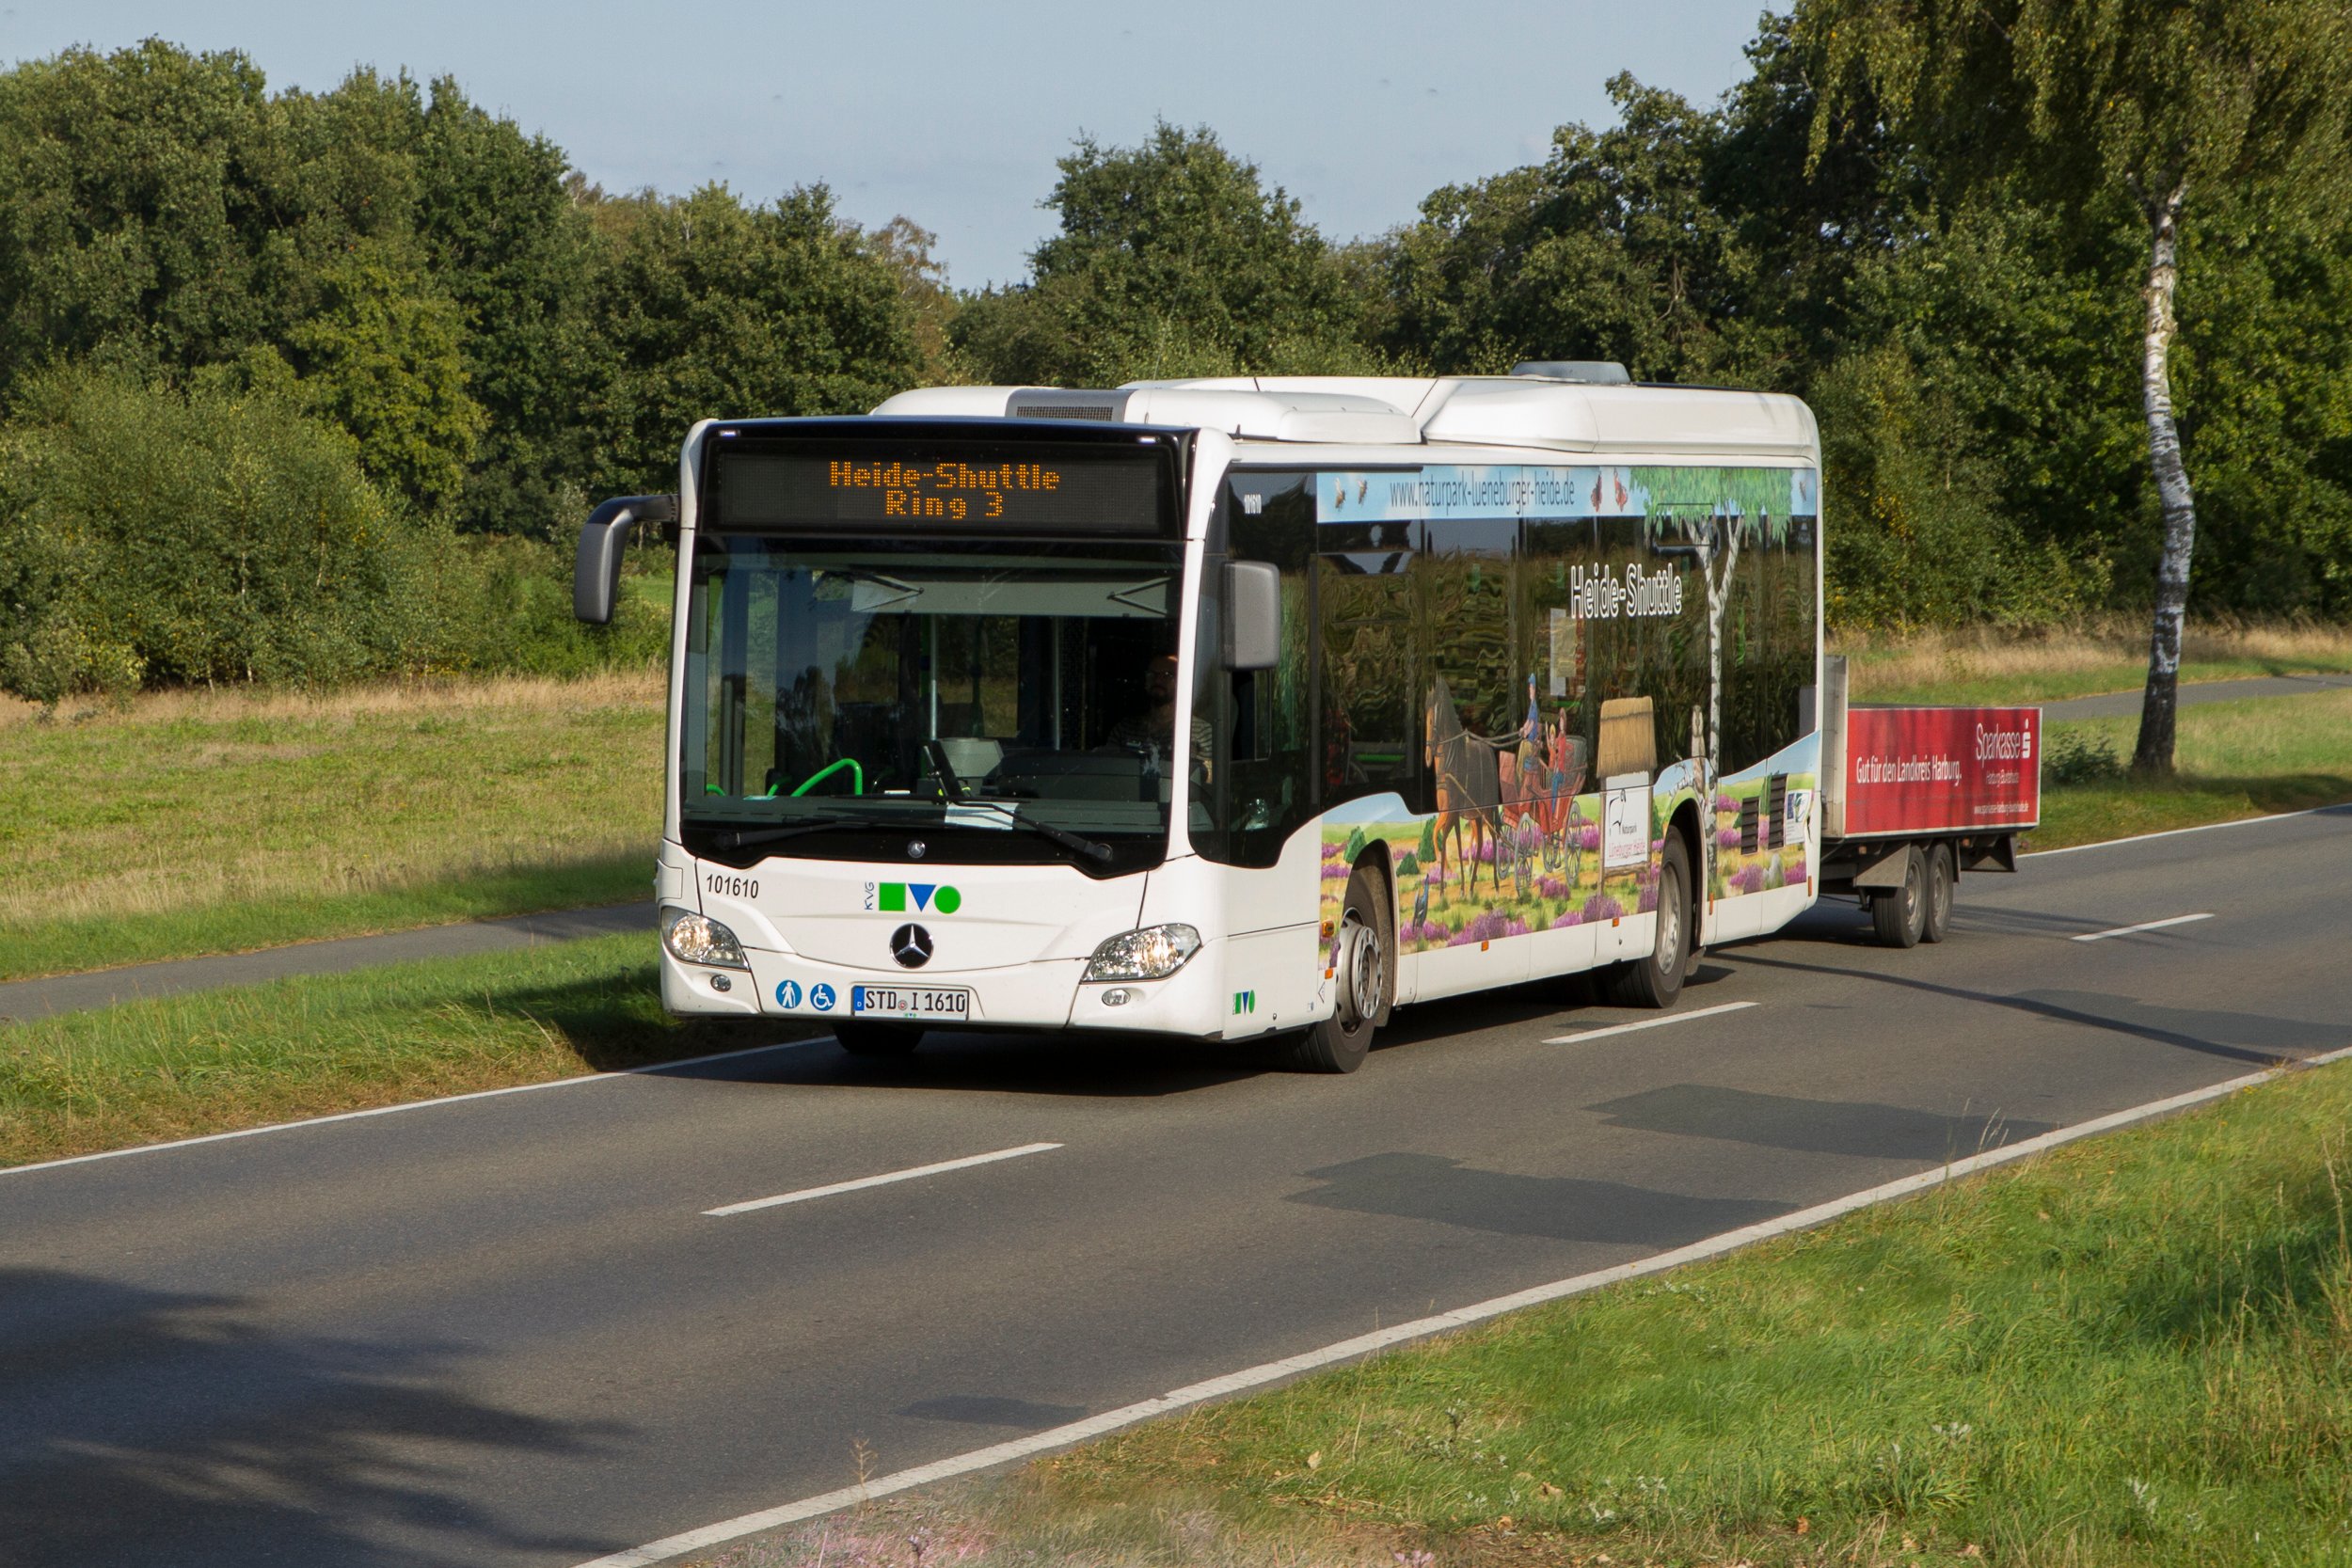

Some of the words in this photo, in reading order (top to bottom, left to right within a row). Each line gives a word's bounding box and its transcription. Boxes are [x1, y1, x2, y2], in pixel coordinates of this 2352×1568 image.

[829, 461, 1060, 491] Heide-Shuttle
[886, 490, 967, 519] Ring
[985, 492, 1004, 517] 3
[1390, 469, 1576, 516] www.naturpark-lueneburger-heide.de
[1570, 562, 1683, 620] Heide-Shuttle
[1975, 722, 2021, 768] Sparkasse
[1856, 755, 1869, 784] Gut
[1870, 755, 1882, 783] für
[1883, 755, 1897, 783] den
[1898, 754, 1931, 783] Landkreis
[1931, 753, 1962, 787] Harburg.
[707, 873, 759, 899] 101610
[864, 881, 874, 911] KVG
[866, 990, 898, 1010] STD
[911, 992, 918, 1011] I
[924, 992, 966, 1013] 1610
